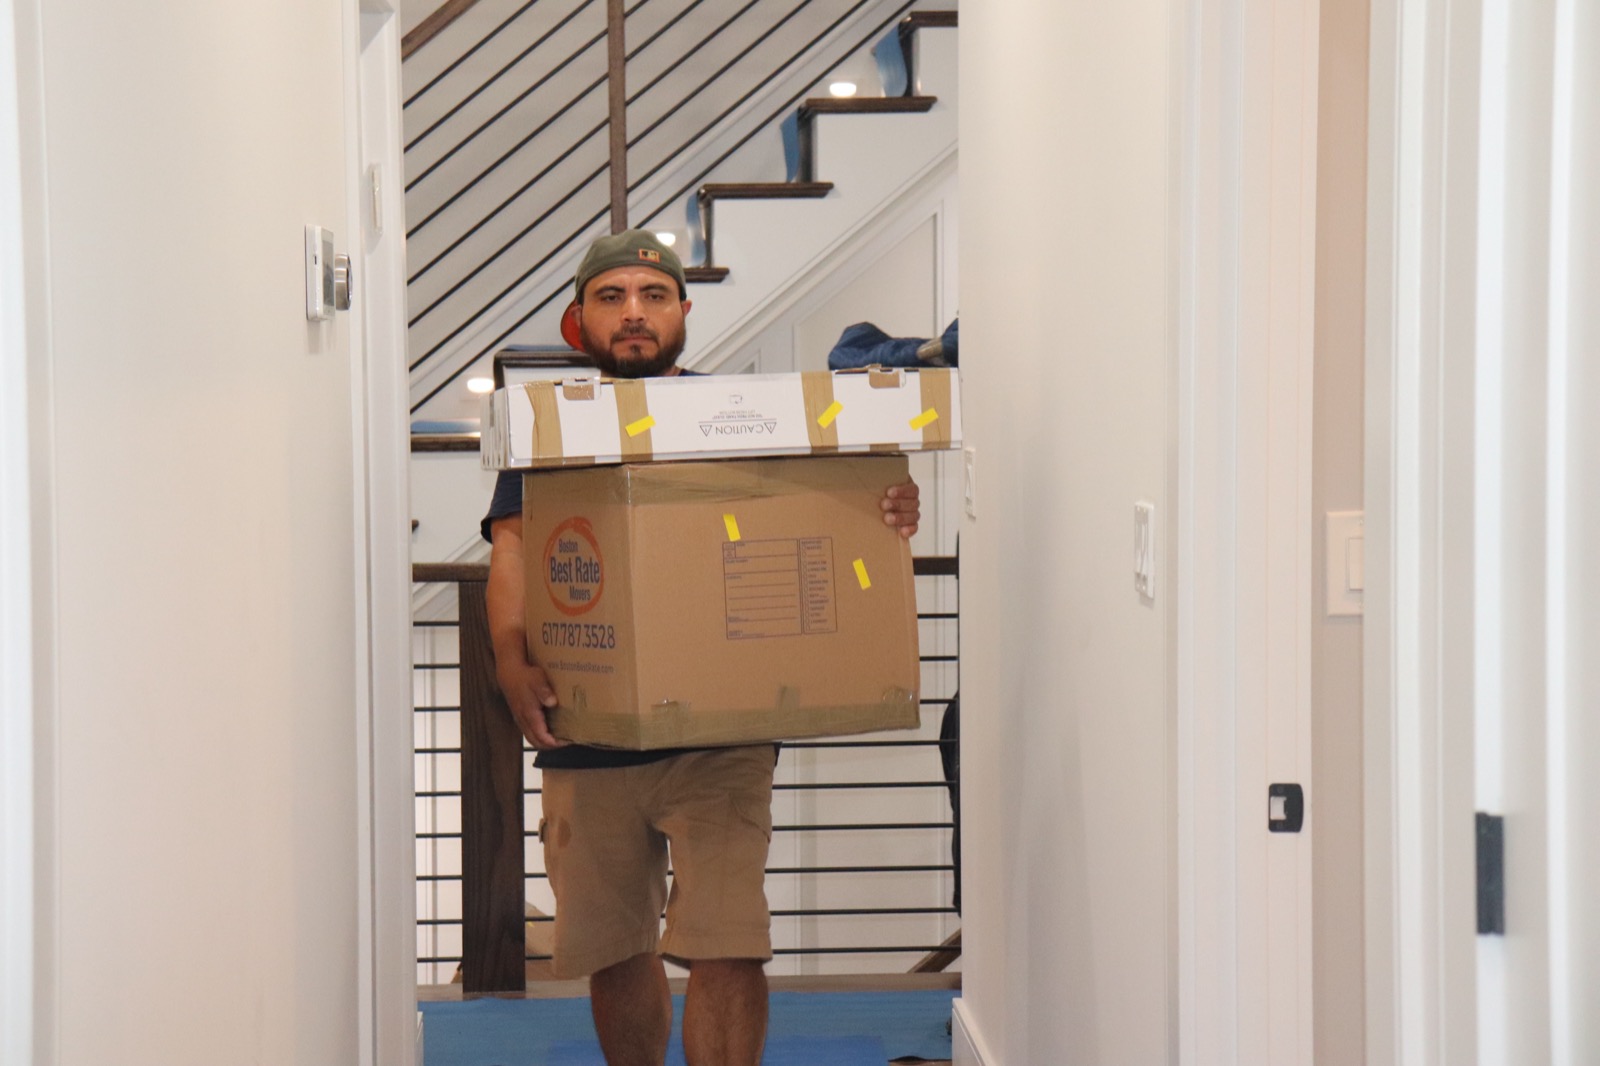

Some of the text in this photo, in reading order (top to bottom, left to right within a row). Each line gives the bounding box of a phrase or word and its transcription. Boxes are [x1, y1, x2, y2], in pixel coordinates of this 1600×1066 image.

[715, 424, 764, 435] CAUTION
[559, 538, 578, 553] Boston
[550, 556, 600, 584] Best Rate
[569, 585, 591, 601] Movers
[542, 622, 616, 649] 617.787.3528
